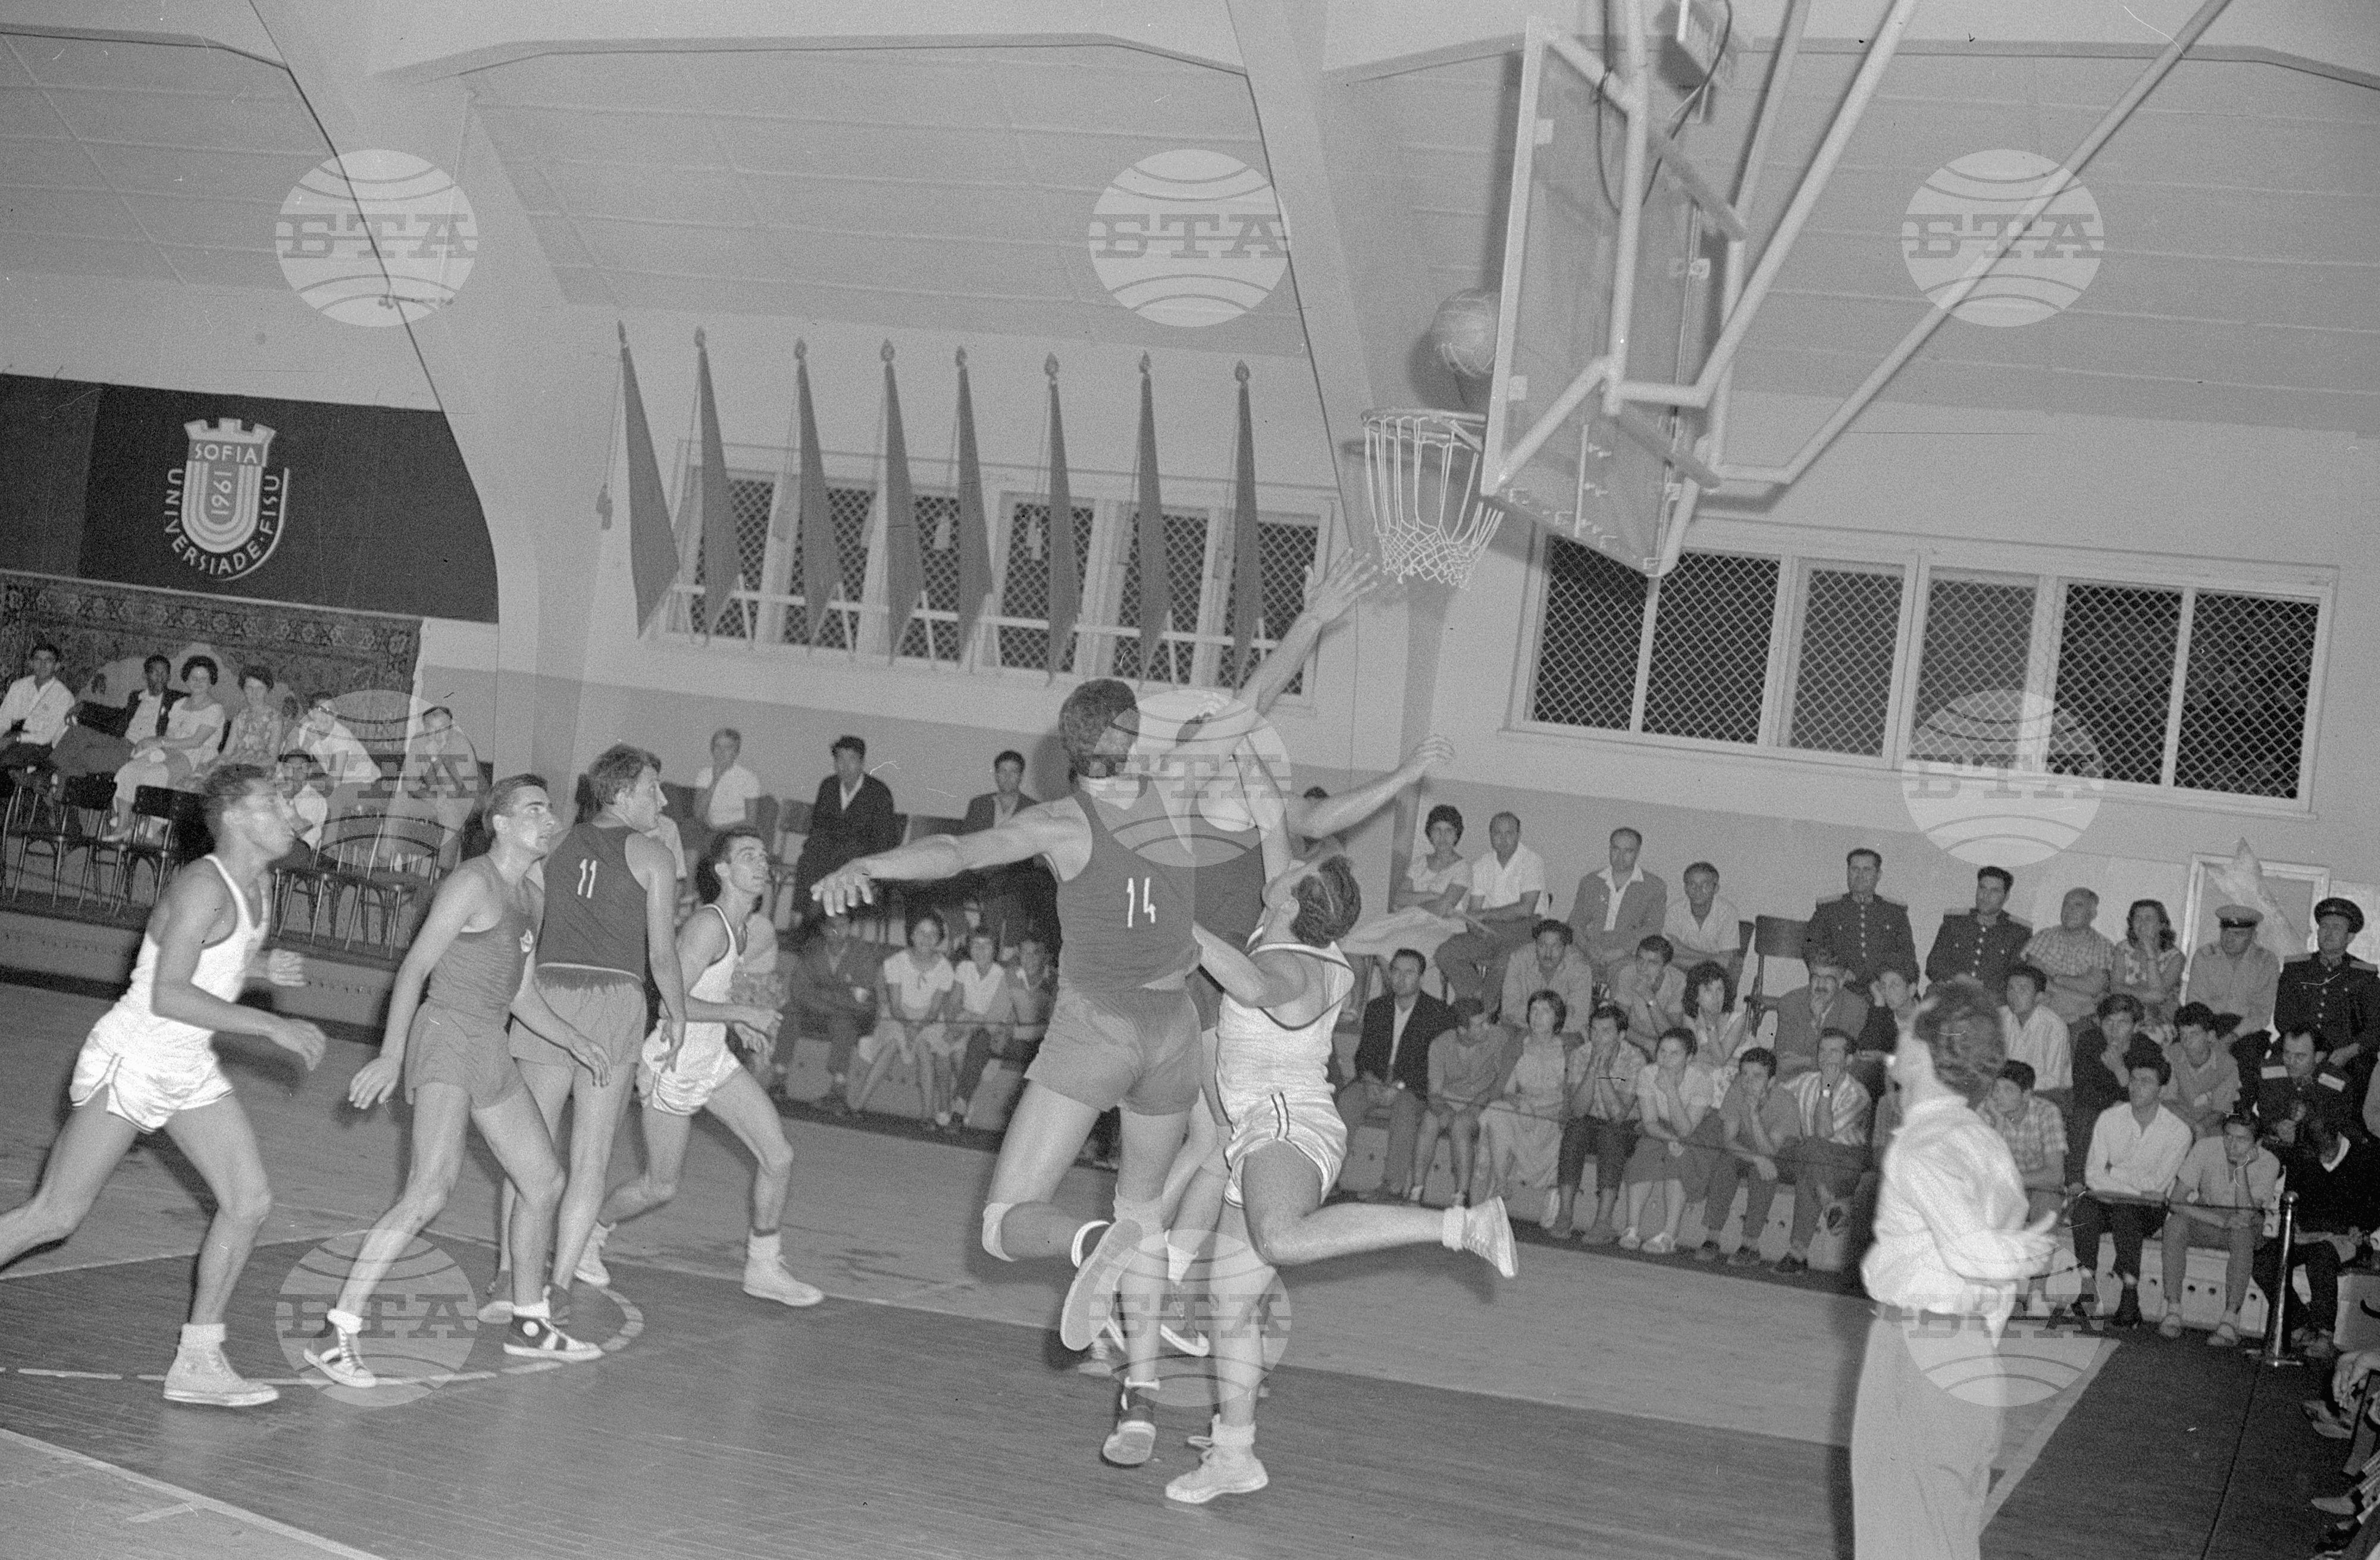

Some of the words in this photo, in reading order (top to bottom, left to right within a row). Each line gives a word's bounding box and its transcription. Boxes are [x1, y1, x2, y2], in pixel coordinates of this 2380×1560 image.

[195, 443, 258, 463] SOFIA
[211, 471, 232, 515] 1961
[577, 858, 597, 898] 11
[1126, 877, 1155, 928] 14
